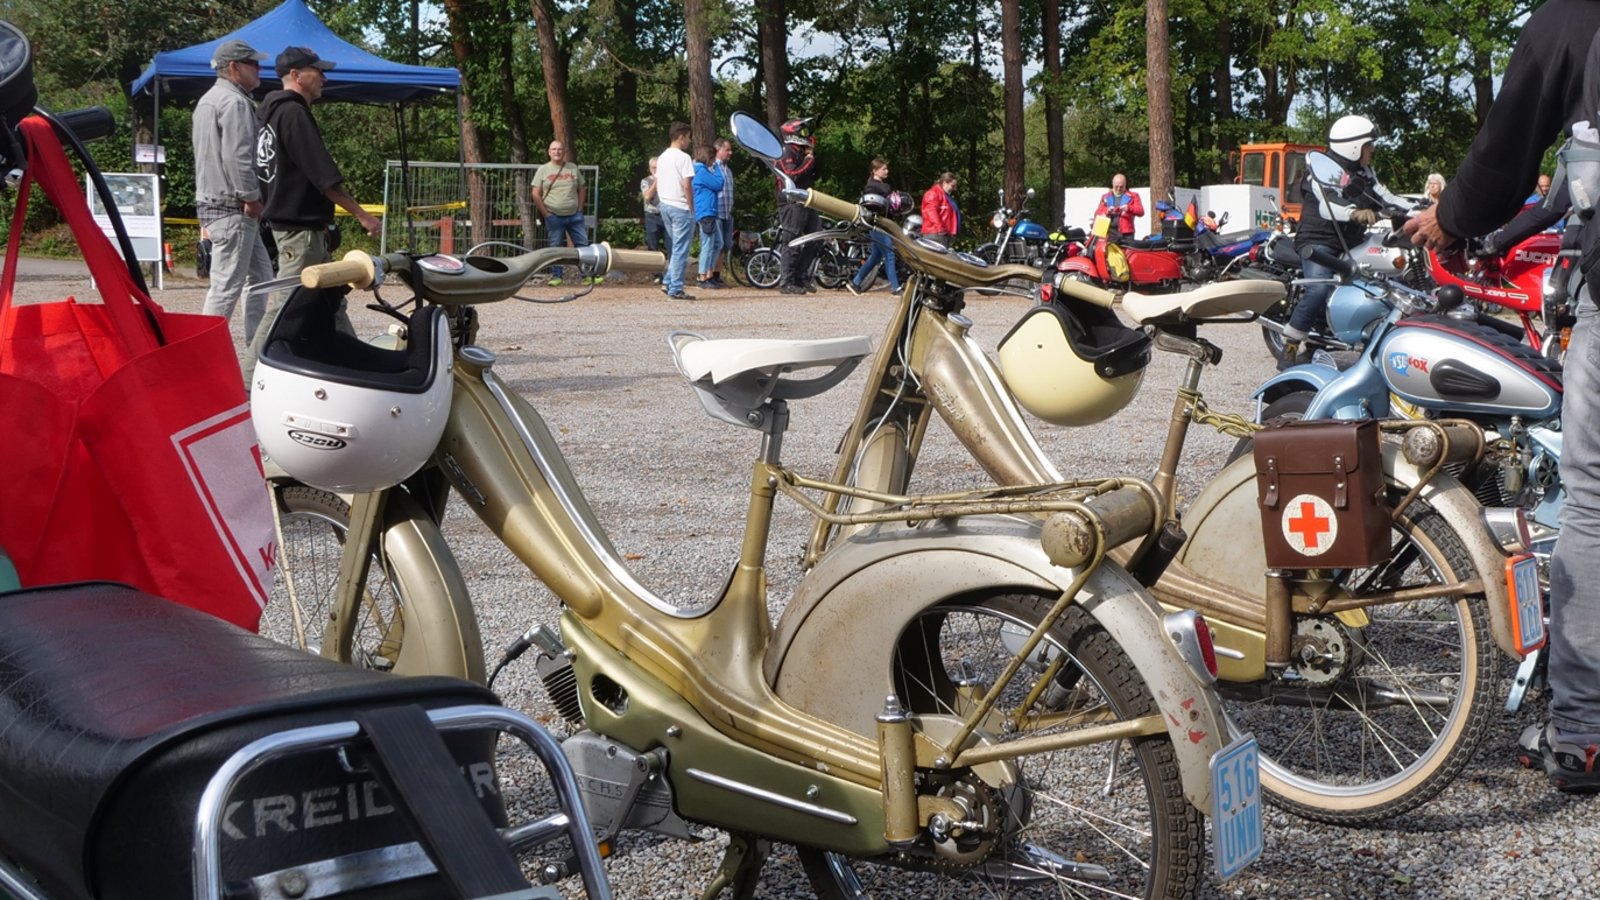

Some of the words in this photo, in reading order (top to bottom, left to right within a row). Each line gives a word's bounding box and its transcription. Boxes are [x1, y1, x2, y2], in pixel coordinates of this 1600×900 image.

[1515, 249, 1559, 265] DUCAT
[1408, 356, 1429, 375] FOX
[221, 762, 497, 840] KREIDR
[1220, 752, 1255, 812] 516
[1224, 803, 1257, 865] UNW
